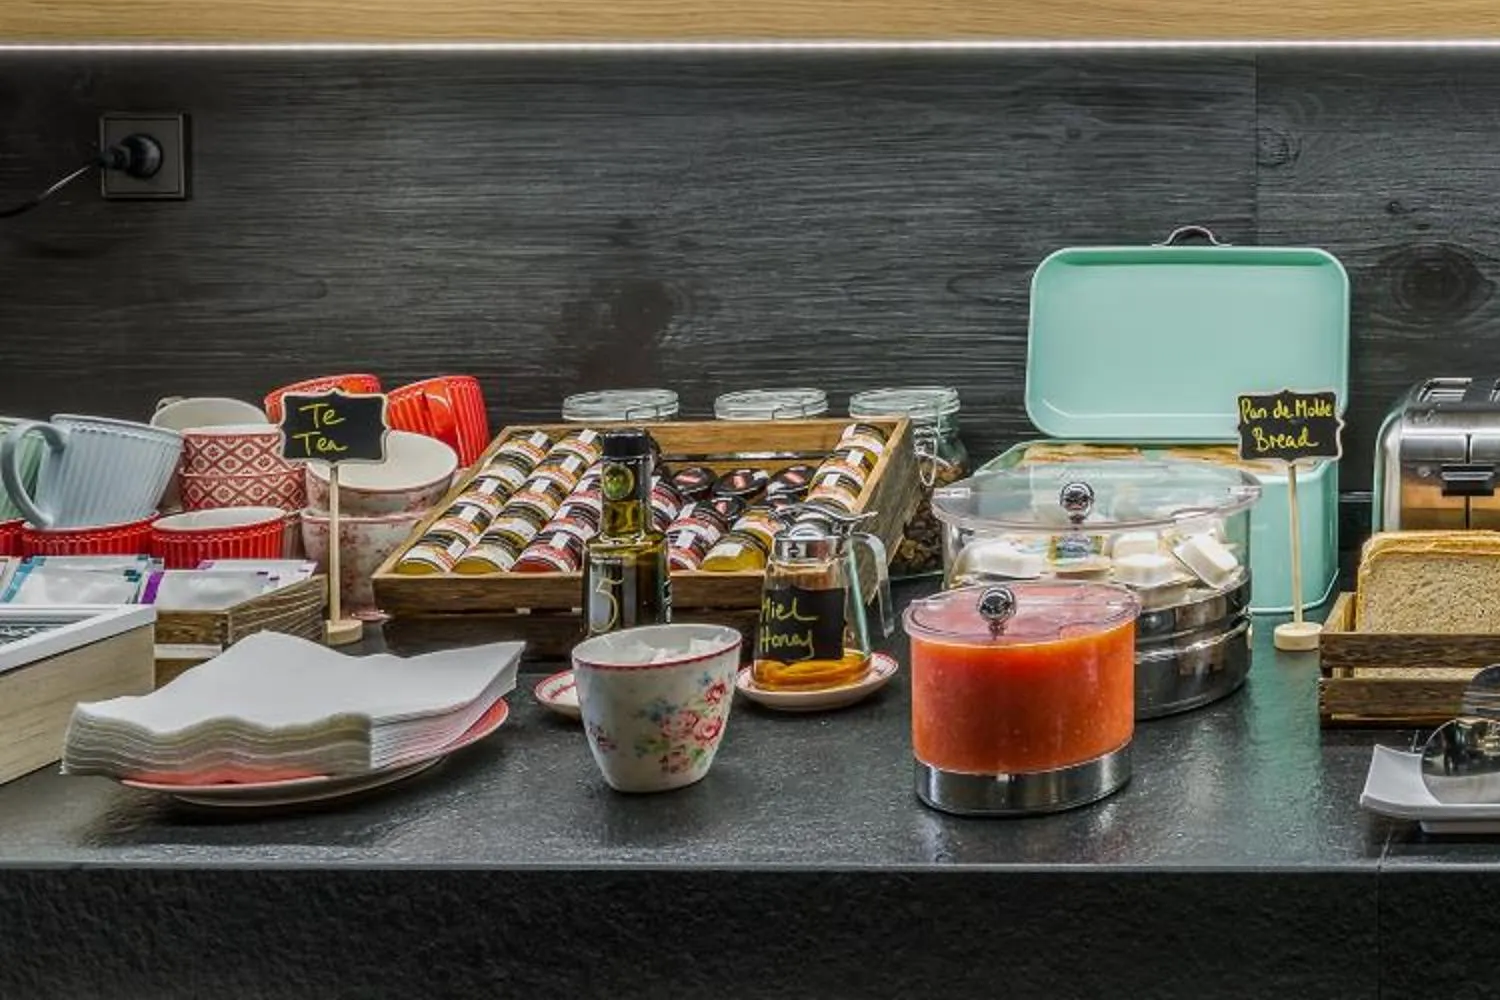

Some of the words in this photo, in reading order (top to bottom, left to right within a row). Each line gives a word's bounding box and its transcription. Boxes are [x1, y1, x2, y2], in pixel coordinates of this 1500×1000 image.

[1241, 398, 1267, 424] Pan
[1273, 399, 1294, 419] de
[292, 431, 348, 456] Tea
[1251, 427, 1319, 452] Bread
[761, 596, 818, 621] Miel
[760, 623, 815, 661] Honey
